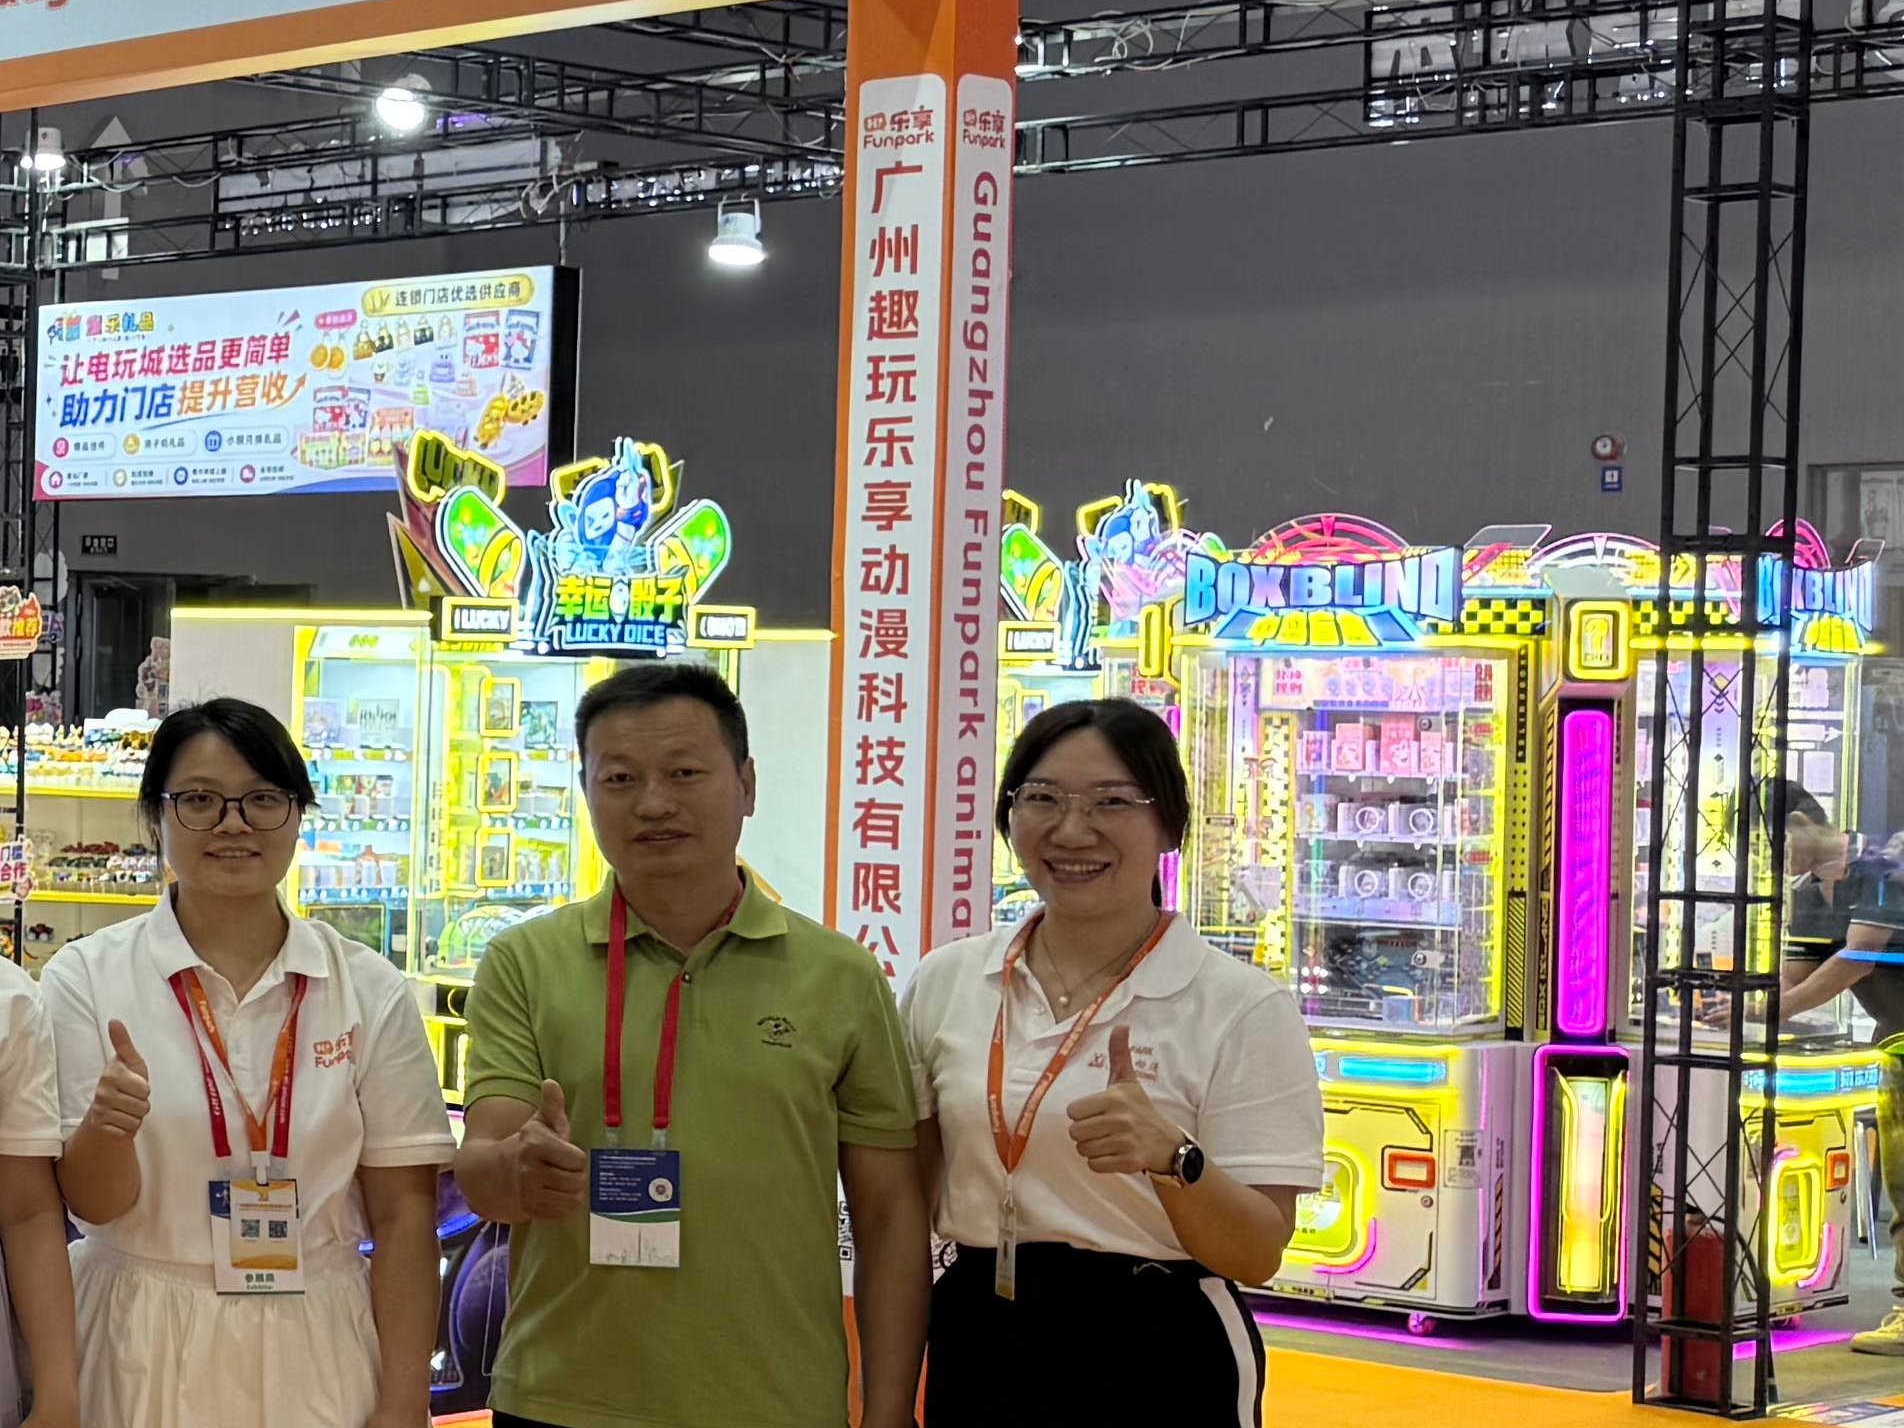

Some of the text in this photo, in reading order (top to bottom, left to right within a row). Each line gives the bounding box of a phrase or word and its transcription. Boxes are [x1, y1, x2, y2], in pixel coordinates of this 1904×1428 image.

[863, 129, 935, 151] Funpark
[962, 129, 1006, 150] Funpark
[58, 331, 292, 388] 让电玩城选品更简单
[58, 369, 290, 428] 助力门店提升营收
[851, 160, 924, 978] 广州趣玩乐享动漫科技有限公
[950, 170, 998, 930] Guangzhou Funpark anima
[565, 621, 666, 646] LUCKY DICE
